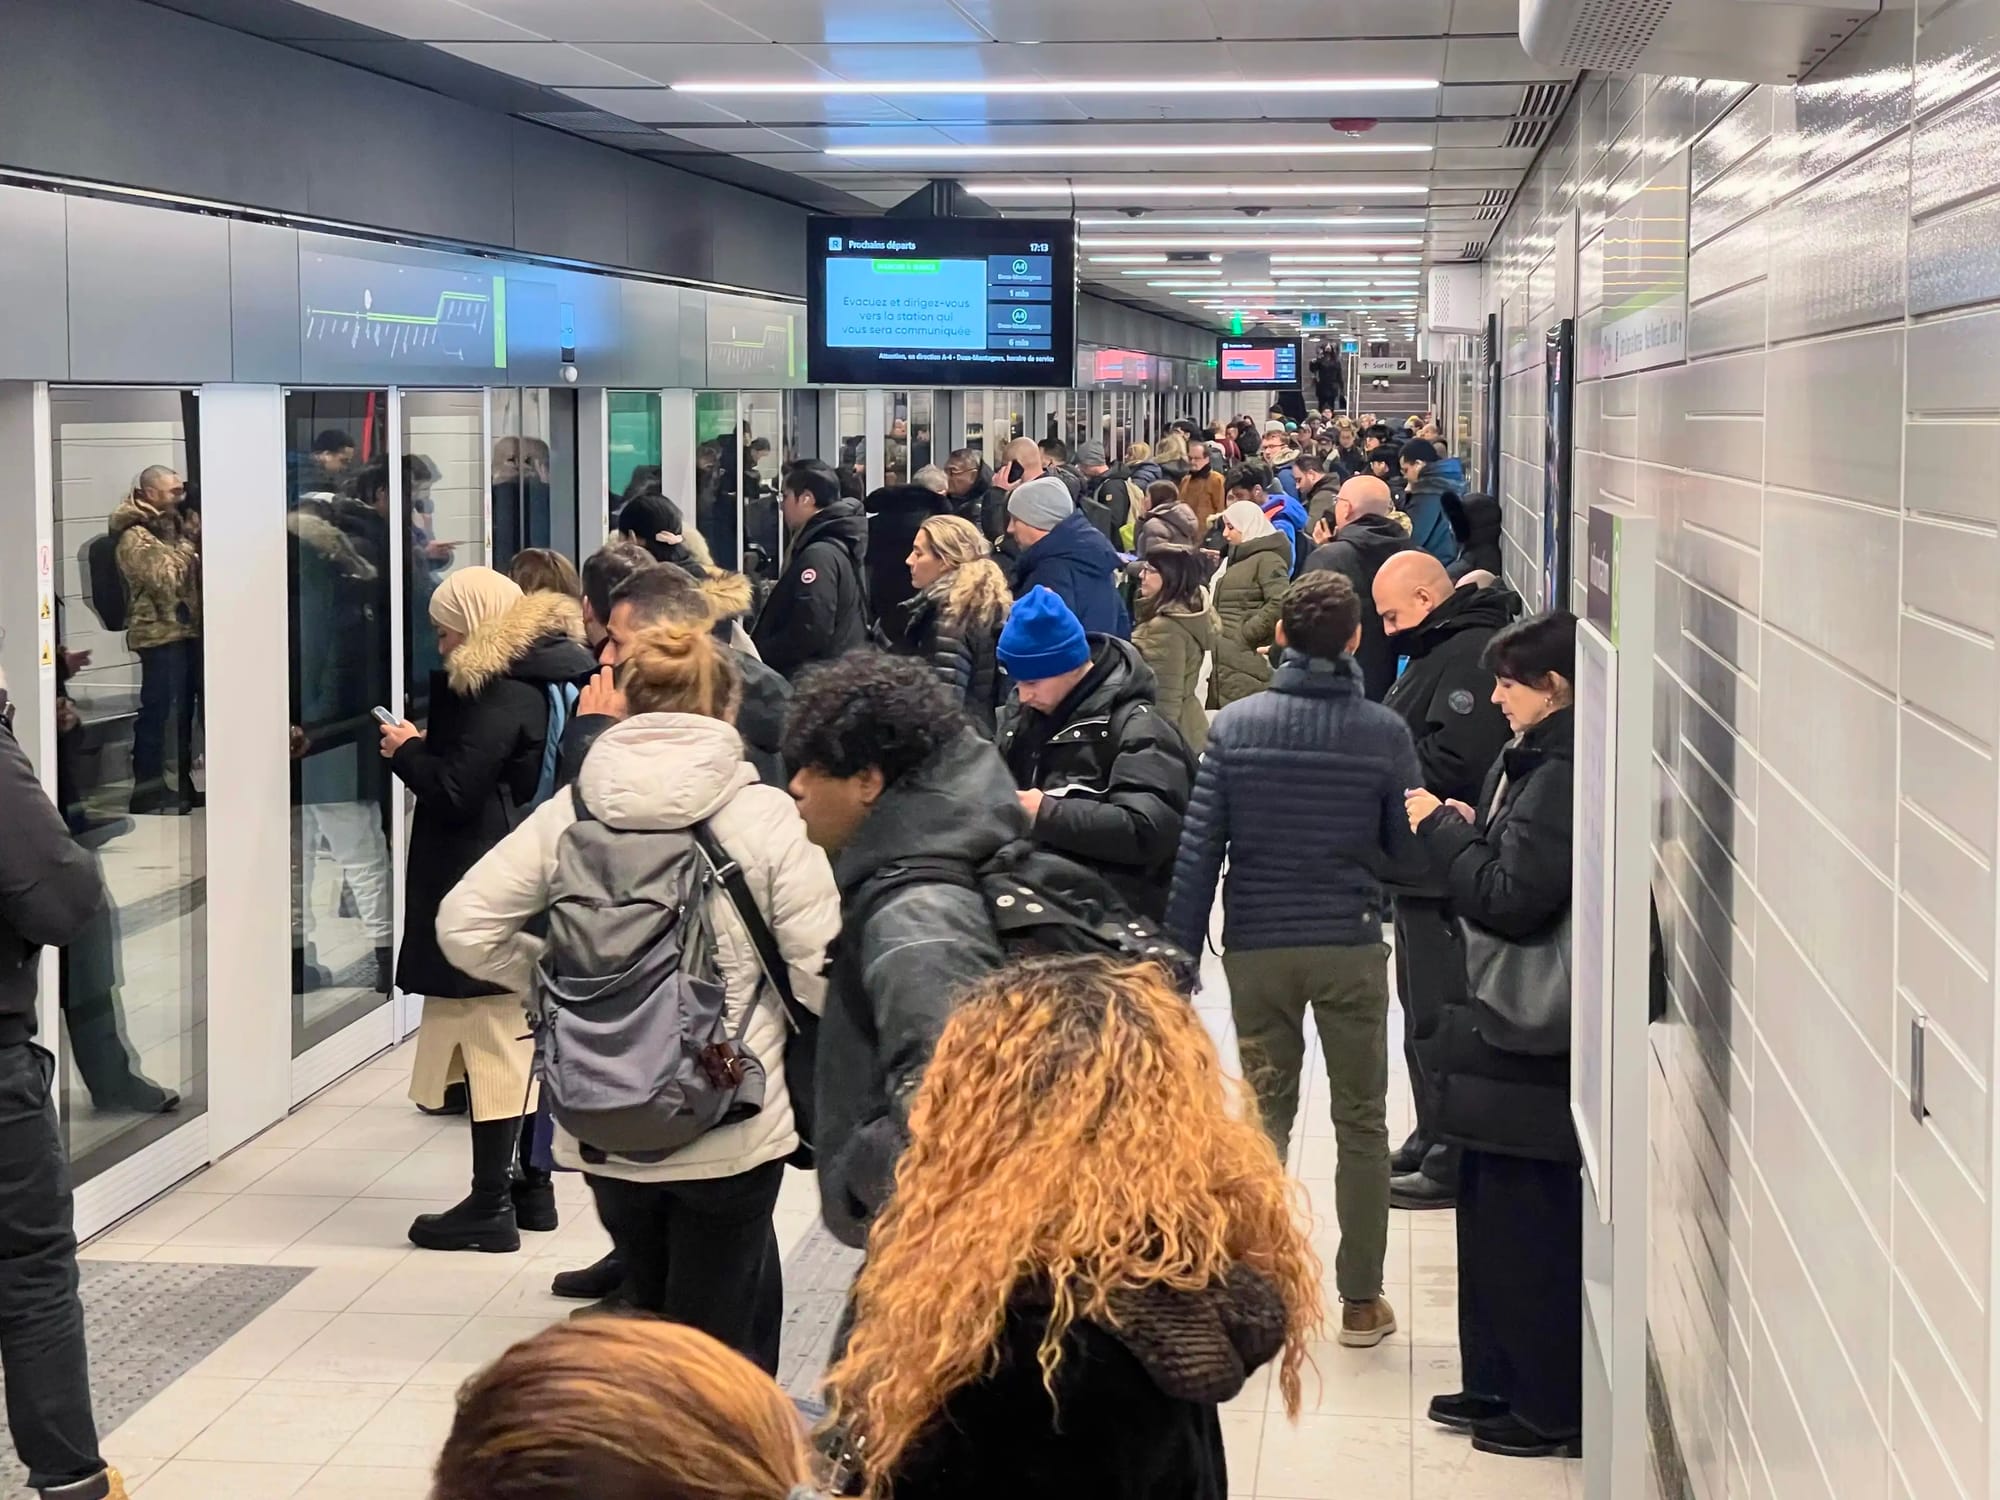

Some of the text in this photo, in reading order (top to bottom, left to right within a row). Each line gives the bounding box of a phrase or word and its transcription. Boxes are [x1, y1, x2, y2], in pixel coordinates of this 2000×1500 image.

[848, 240, 917, 252] Prochains départs
[1030, 243, 1049, 252] 17:13
[1009, 289, 1014, 297] 1
[890, 298, 900, 307] et
[903, 297, 970, 310] dirigez-vous
[859, 311, 953, 324] vers la station qui
[842, 326, 867, 334] vous
[894, 325, 971, 337] communiquée
[1009, 338, 1014, 346] 6
[1372, 361, 1394, 369] Sortie
